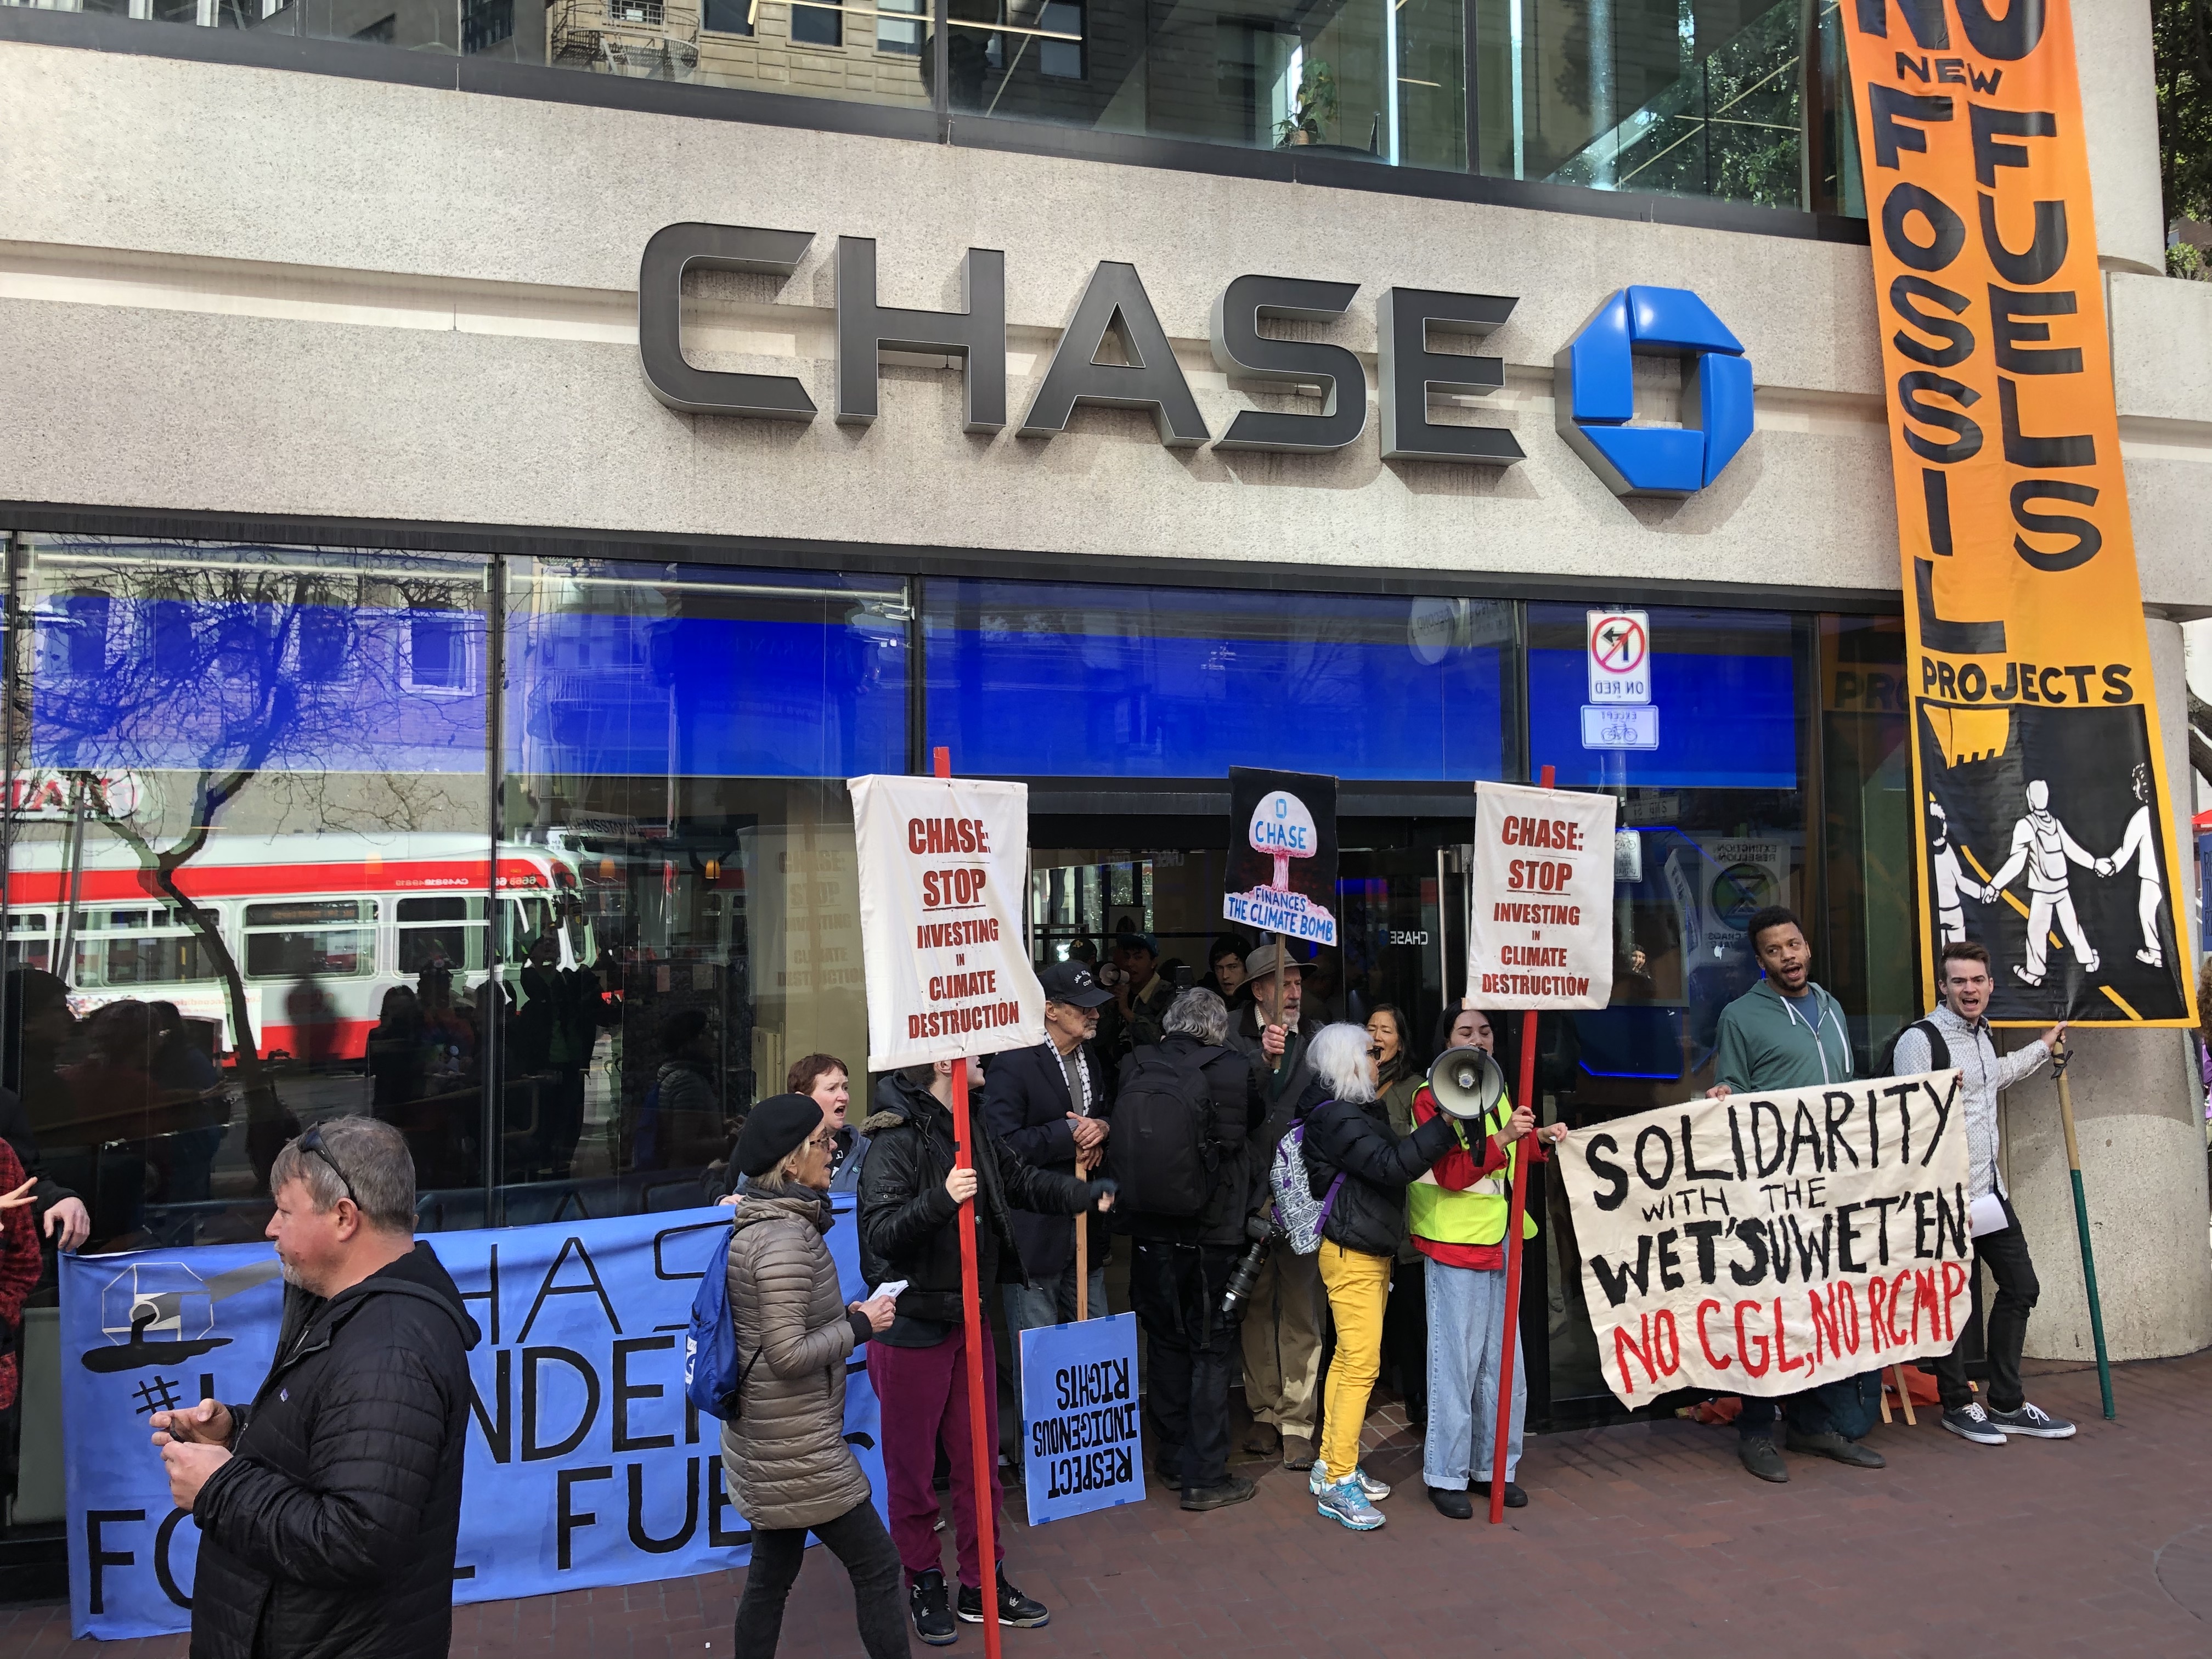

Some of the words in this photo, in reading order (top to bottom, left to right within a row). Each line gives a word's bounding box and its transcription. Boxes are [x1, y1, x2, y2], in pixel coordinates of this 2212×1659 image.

[1895, 51, 2004, 95] NEW
[639, 221, 1526, 466] CHASE
[1967, 100, 2102, 572] FUELS
[1868, 82, 2007, 654] FOSSIL
[1921, 656, 2134, 704] PROJECTS
[908, 817, 991, 854] CHASE:
[1255, 821, 1307, 849] CHASE
[1502, 815, 1584, 851] CHASE:
[923, 868, 986, 907] STOP
[1508, 859, 1572, 891] STOP
[1228, 896, 1246, 921] THE
[1250, 904, 1297, 933] CLIMATE
[1300, 915, 1334, 942] BOMB
[1255, 887, 1306, 913] FINANCES
[1493, 902, 1581, 926] INVESTING
[917, 918, 999, 949] INVESTING
[1532, 930, 1540, 941] IN
[956, 953, 965, 966] IN
[1501, 945, 1567, 967] CLIMATE
[929, 970, 996, 1001] CLIMATE
[1482, 973, 1589, 996] DESTRUCTION
[908, 1001, 1019, 1039] DESTRUCTION
[1585, 1075, 1957, 1211] SOLIDARITY
[1642, 1186, 1730, 1222] WITH
[1759, 1177, 1827, 1213] THE
[1589, 1182, 1968, 1308] WET'SUWET'EN
[1613, 1309, 1680, 1394] NO
[1809, 1279, 1859, 1365] NO
[1868, 1261, 1967, 1354] RCMP
[1056, 1357, 1130, 1410] RIGHTS
[1032, 1402, 1138, 1458] INDIGENOUS
[1047, 1446, 1133, 1500] RESPECT
